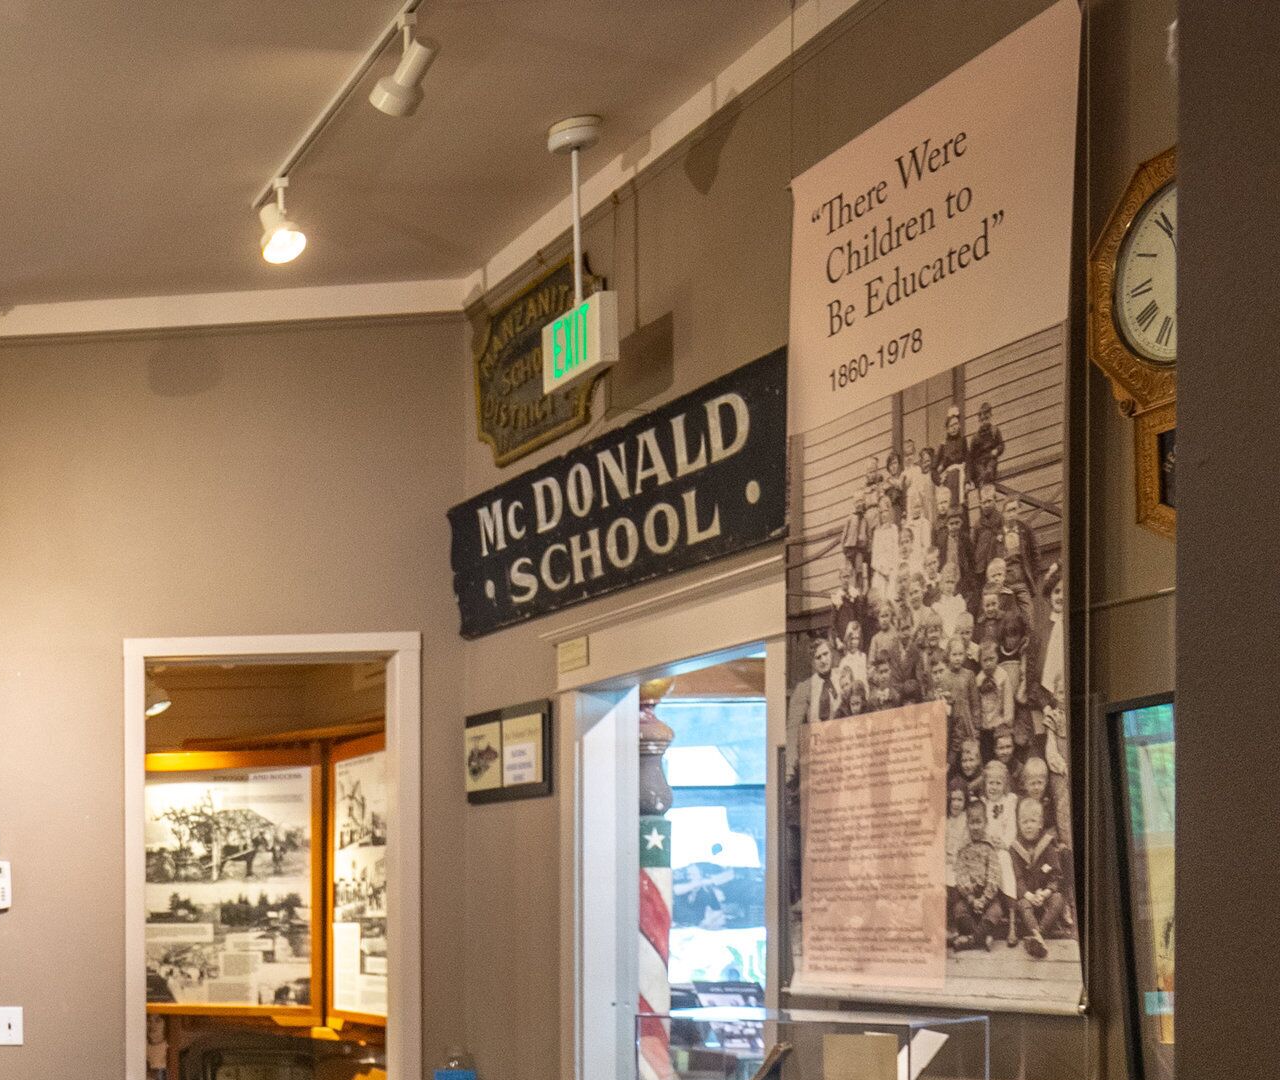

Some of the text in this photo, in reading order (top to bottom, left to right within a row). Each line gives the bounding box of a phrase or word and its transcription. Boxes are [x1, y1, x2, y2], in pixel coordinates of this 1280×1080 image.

[811, 131, 967, 236] “There Were
[826, 187, 973, 284] Children to
[827, 209, 1004, 338] Be Educated”
[553, 303, 590, 379] EXIT
[828, 328, 923, 391] 1860-1978
[510, 490, 721, 604] SCHOOL
